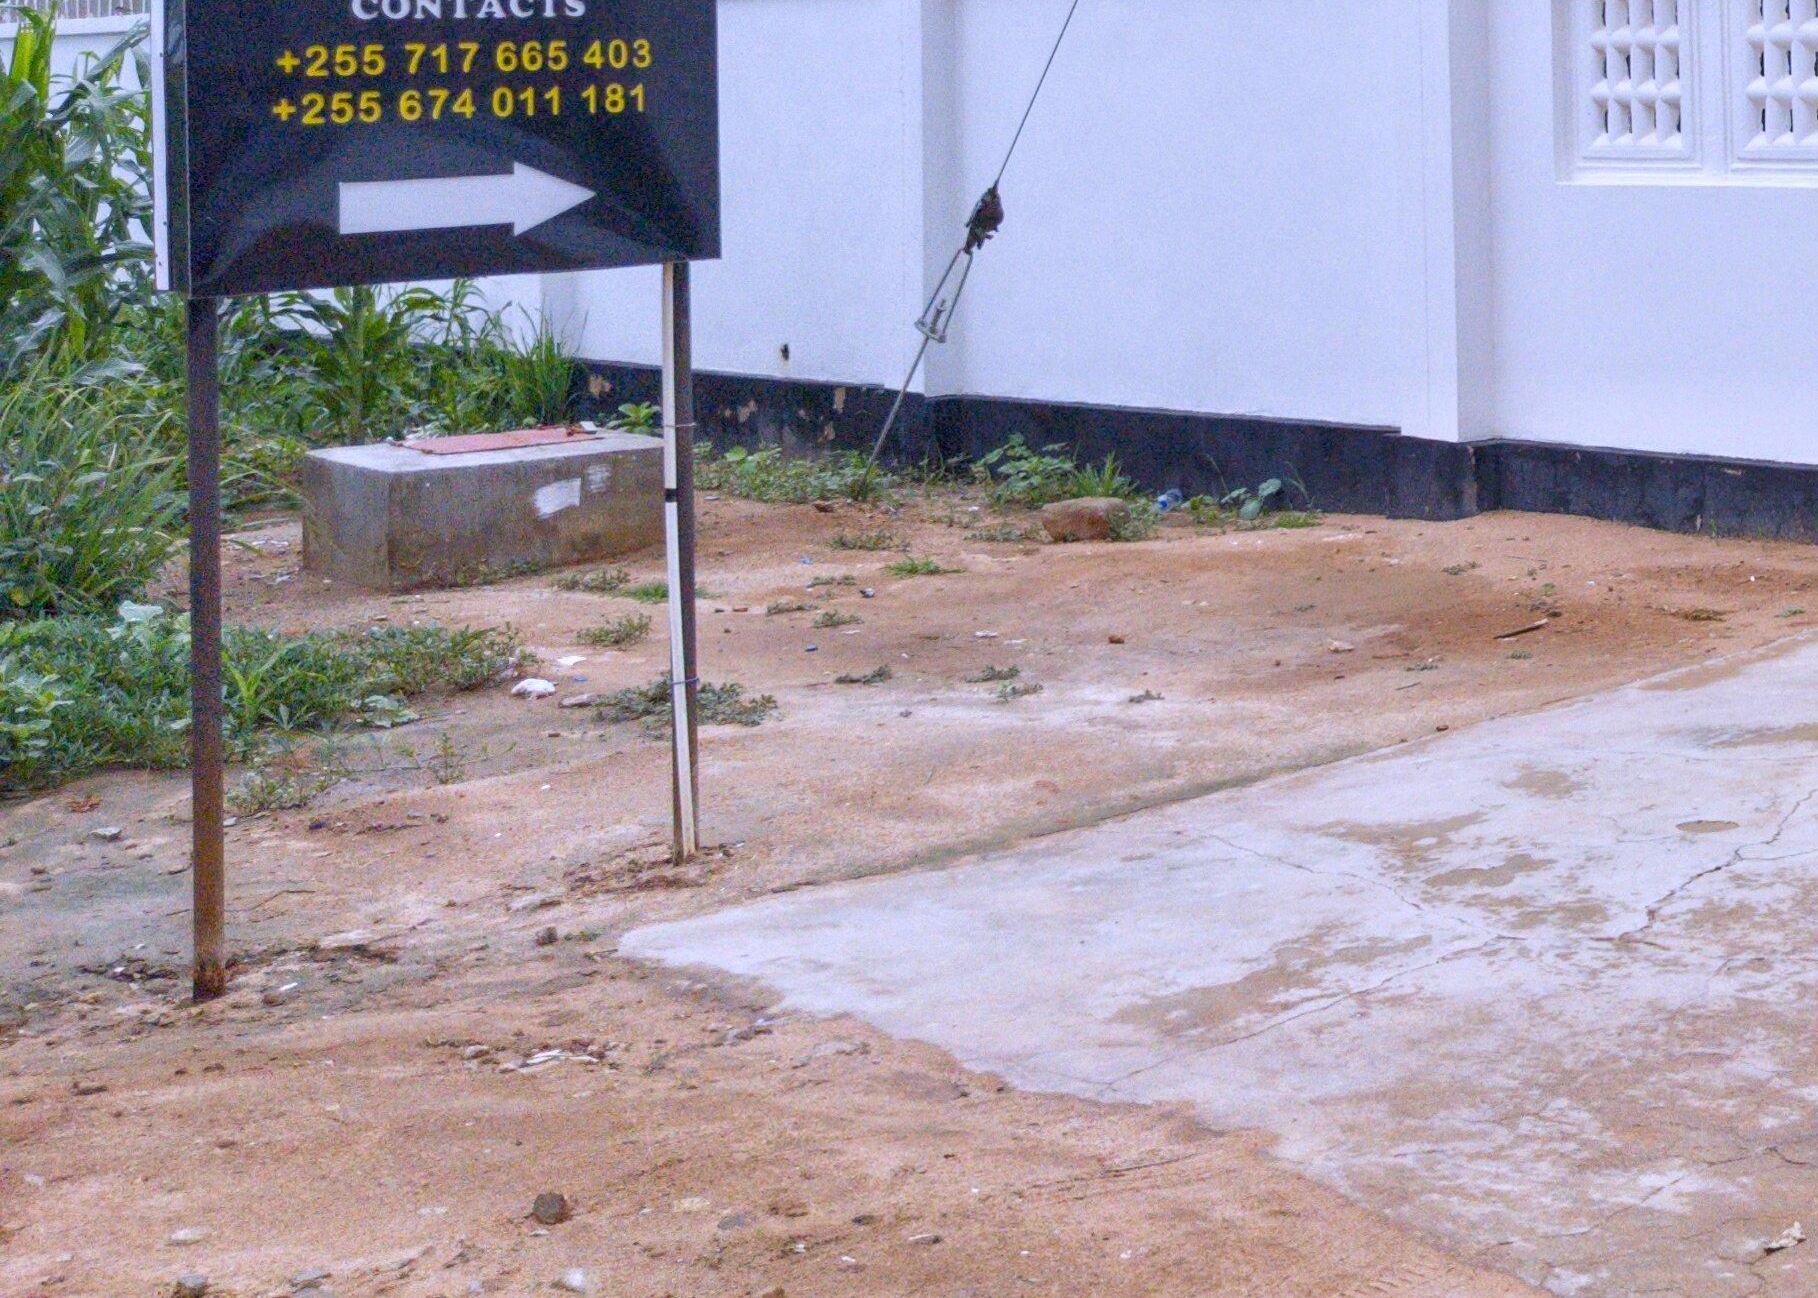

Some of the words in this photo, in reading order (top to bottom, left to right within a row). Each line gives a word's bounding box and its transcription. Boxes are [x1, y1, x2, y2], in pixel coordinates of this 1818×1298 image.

[277, 44, 385, 77] +255
[406, 42, 477, 75] 717
[496, 40, 568, 72] 665
[583, 38, 652, 70] 403
[273, 90, 382, 125] +255
[399, 88, 476, 121] 674
[492, 86, 561, 118] 011
[582, 83, 646, 114] 181
